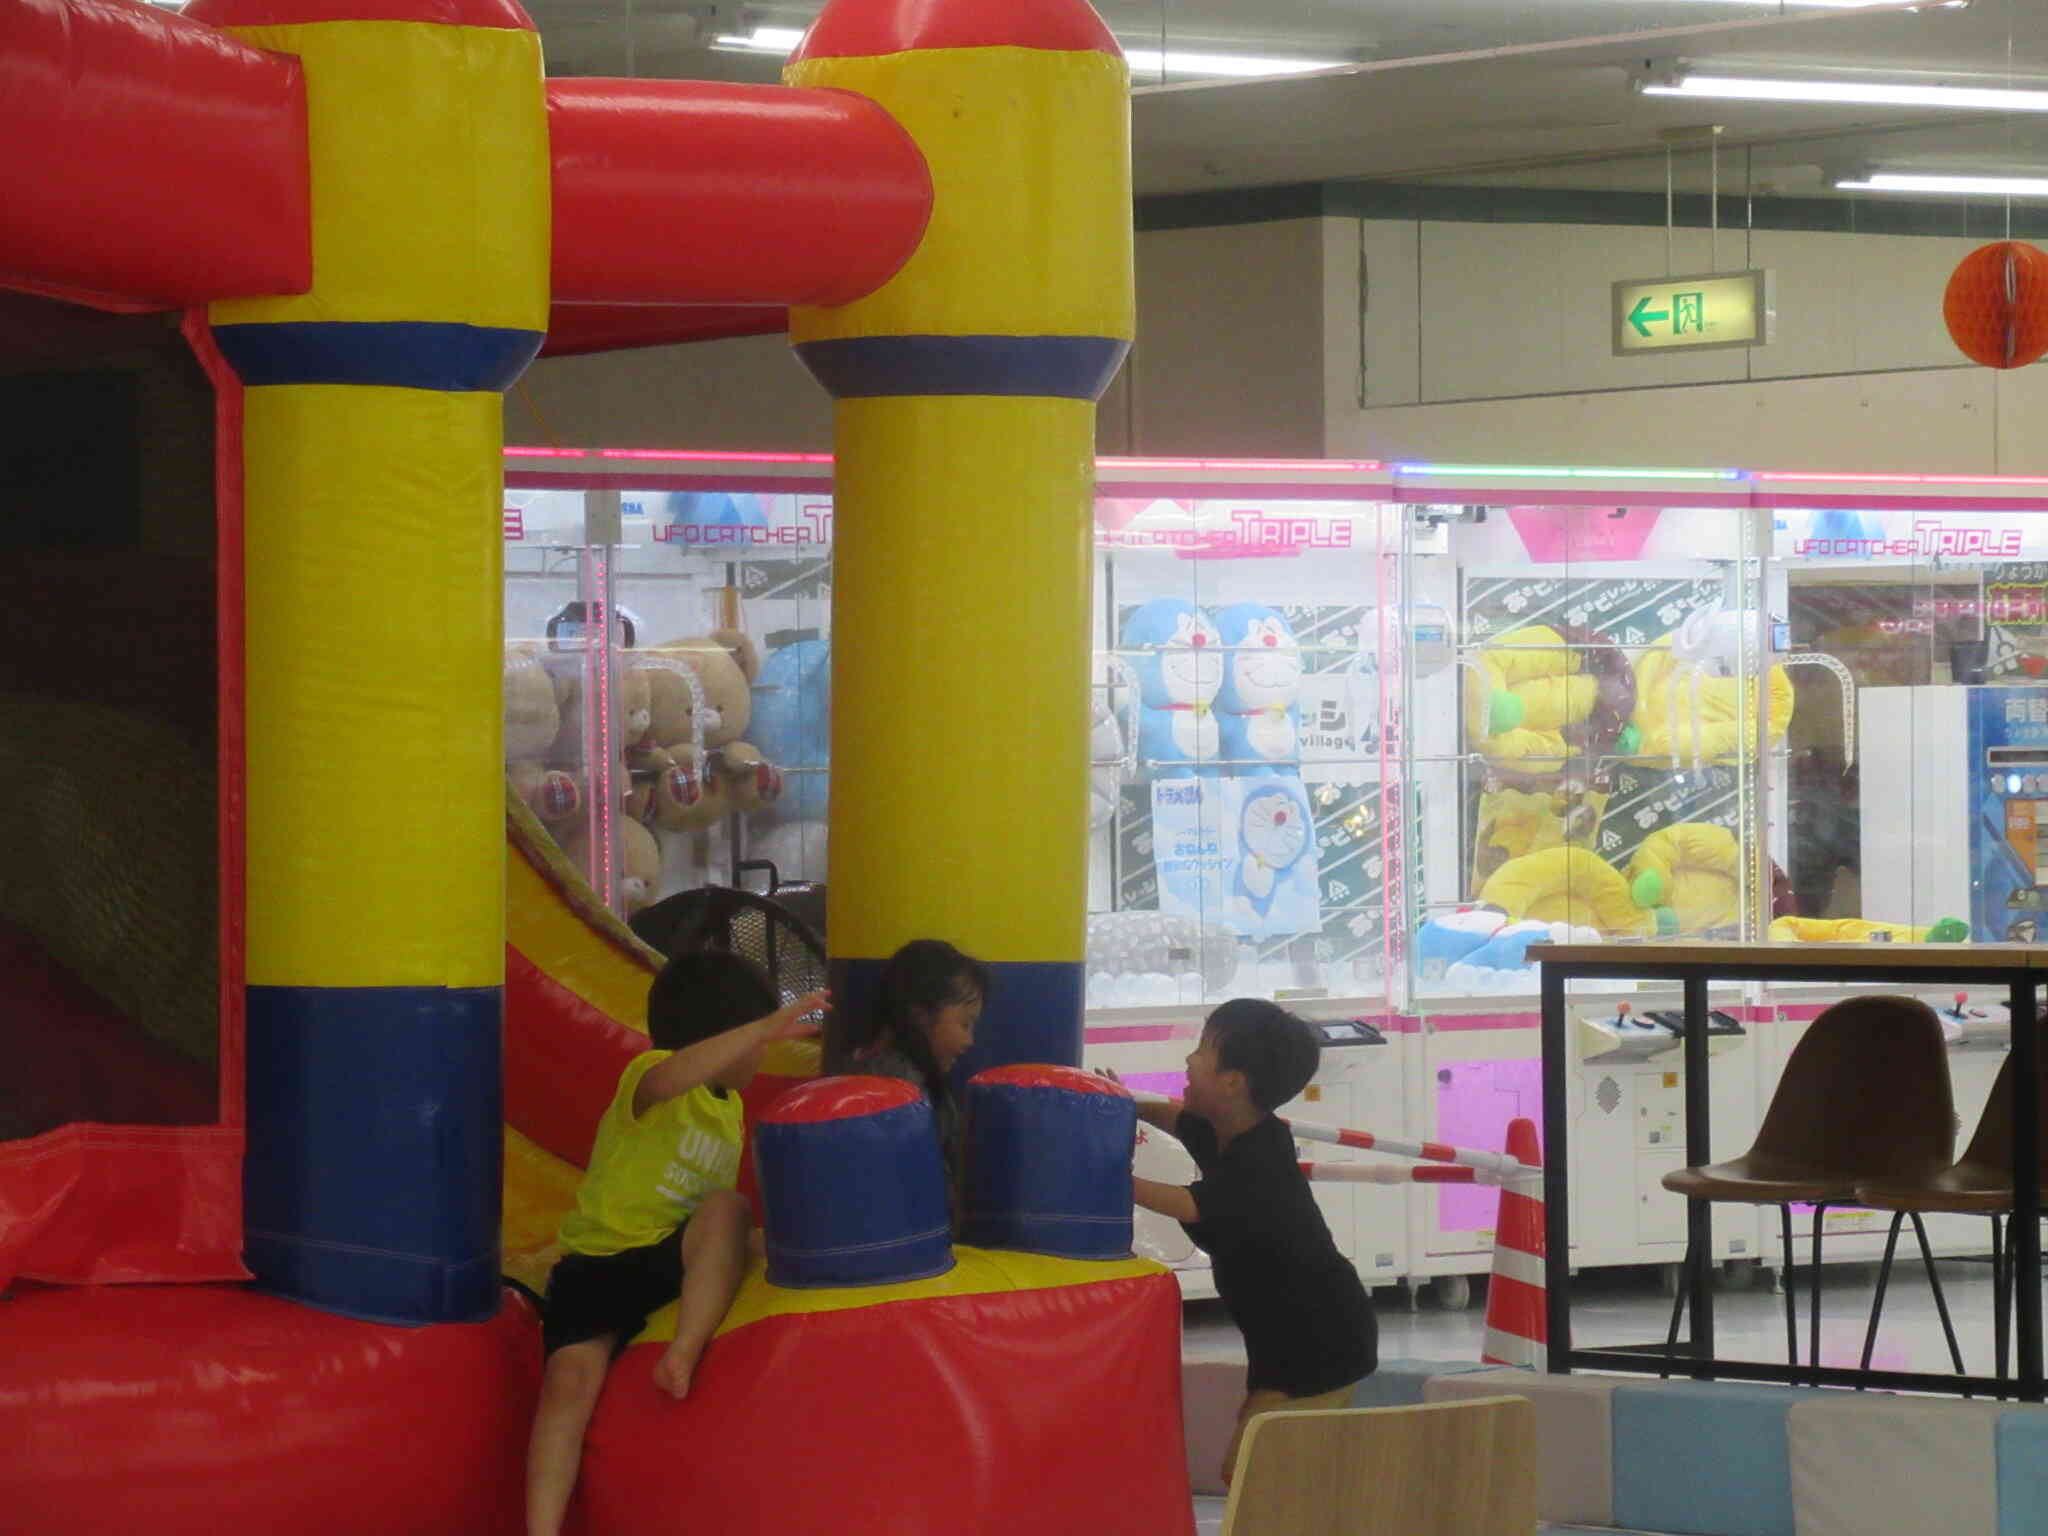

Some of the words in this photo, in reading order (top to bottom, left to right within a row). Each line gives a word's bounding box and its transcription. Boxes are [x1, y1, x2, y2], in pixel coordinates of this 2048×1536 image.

[652, 525, 700, 543] UFO
[703, 525, 811, 545] CATCHER
[1231, 510, 1352, 548] TRIPLE
[1794, 540, 1831, 555] UFO
[1834, 540, 1921, 556] CATCHER
[1915, 520, 2022, 557] TRIPLE
